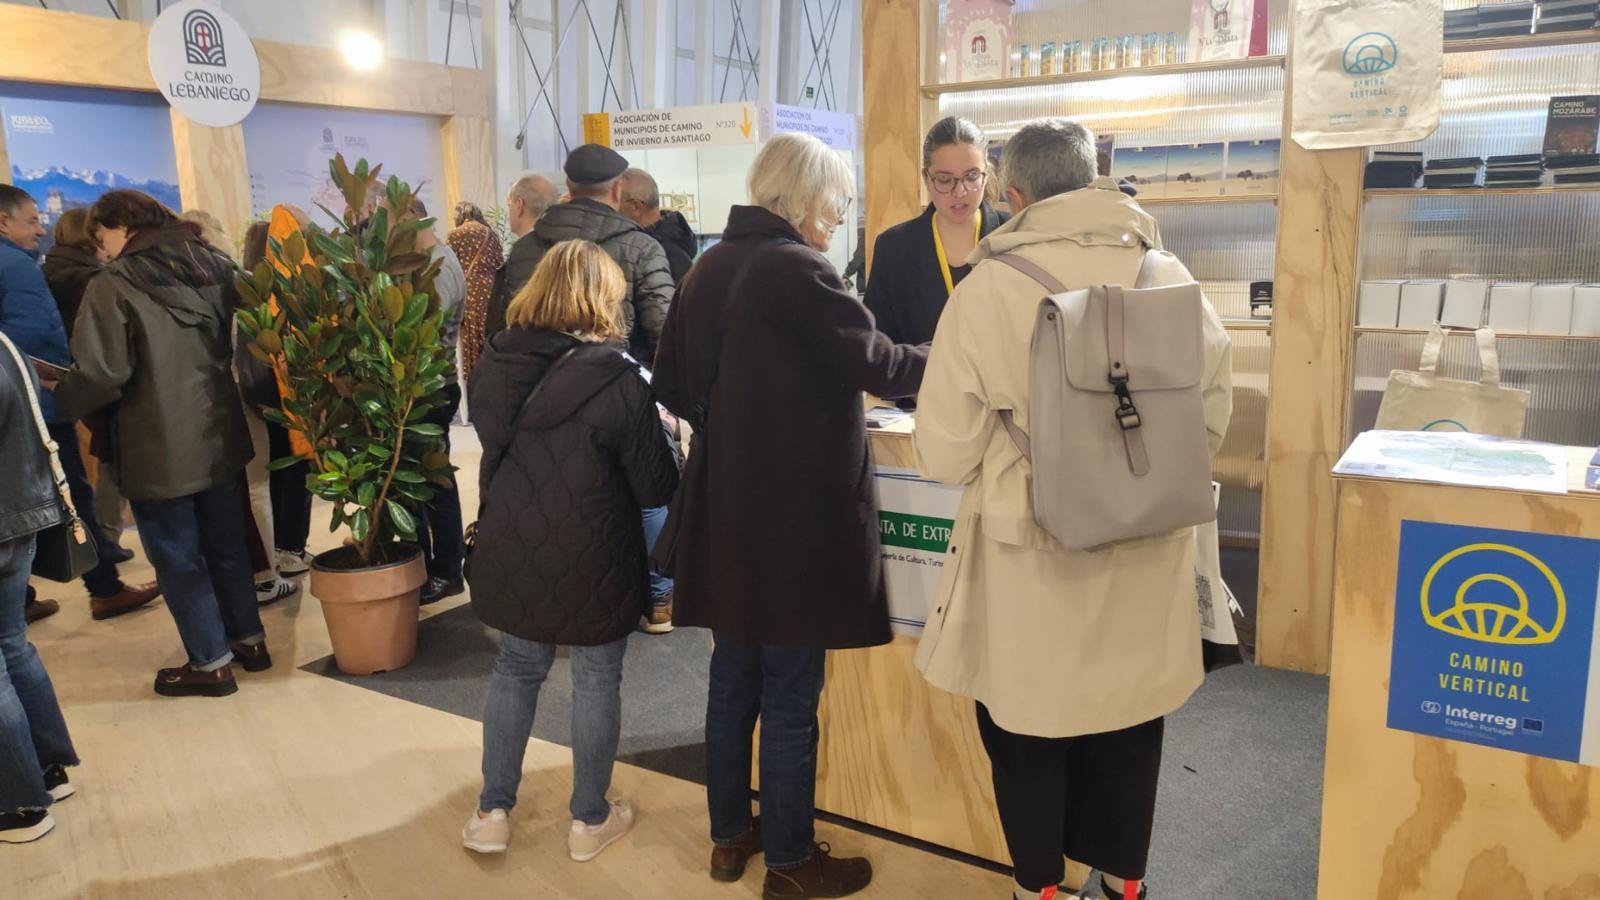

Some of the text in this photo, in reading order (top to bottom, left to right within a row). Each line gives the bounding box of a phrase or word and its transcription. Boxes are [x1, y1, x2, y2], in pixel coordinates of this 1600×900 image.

[184, 70, 233, 85] CAMINO
[169, 82, 251, 102] LEBANIEGO
[613, 112, 672, 124] ASOCIACIÓN DE
[614, 124, 657, 135] MUNICIPIOS
[659, 124, 670, 133] DE
[671, 122, 703, 132] CAMINO
[614, 133, 711, 147] DE INVIERNO A SANTIAGO
[902, 522, 917, 538] DE
[1449, 652, 1523, 678] CAMINO
[1439, 673, 1531, 703] VERTICAL
[1445, 704, 1518, 730] Interreg
[1445, 718, 1474, 730] España
